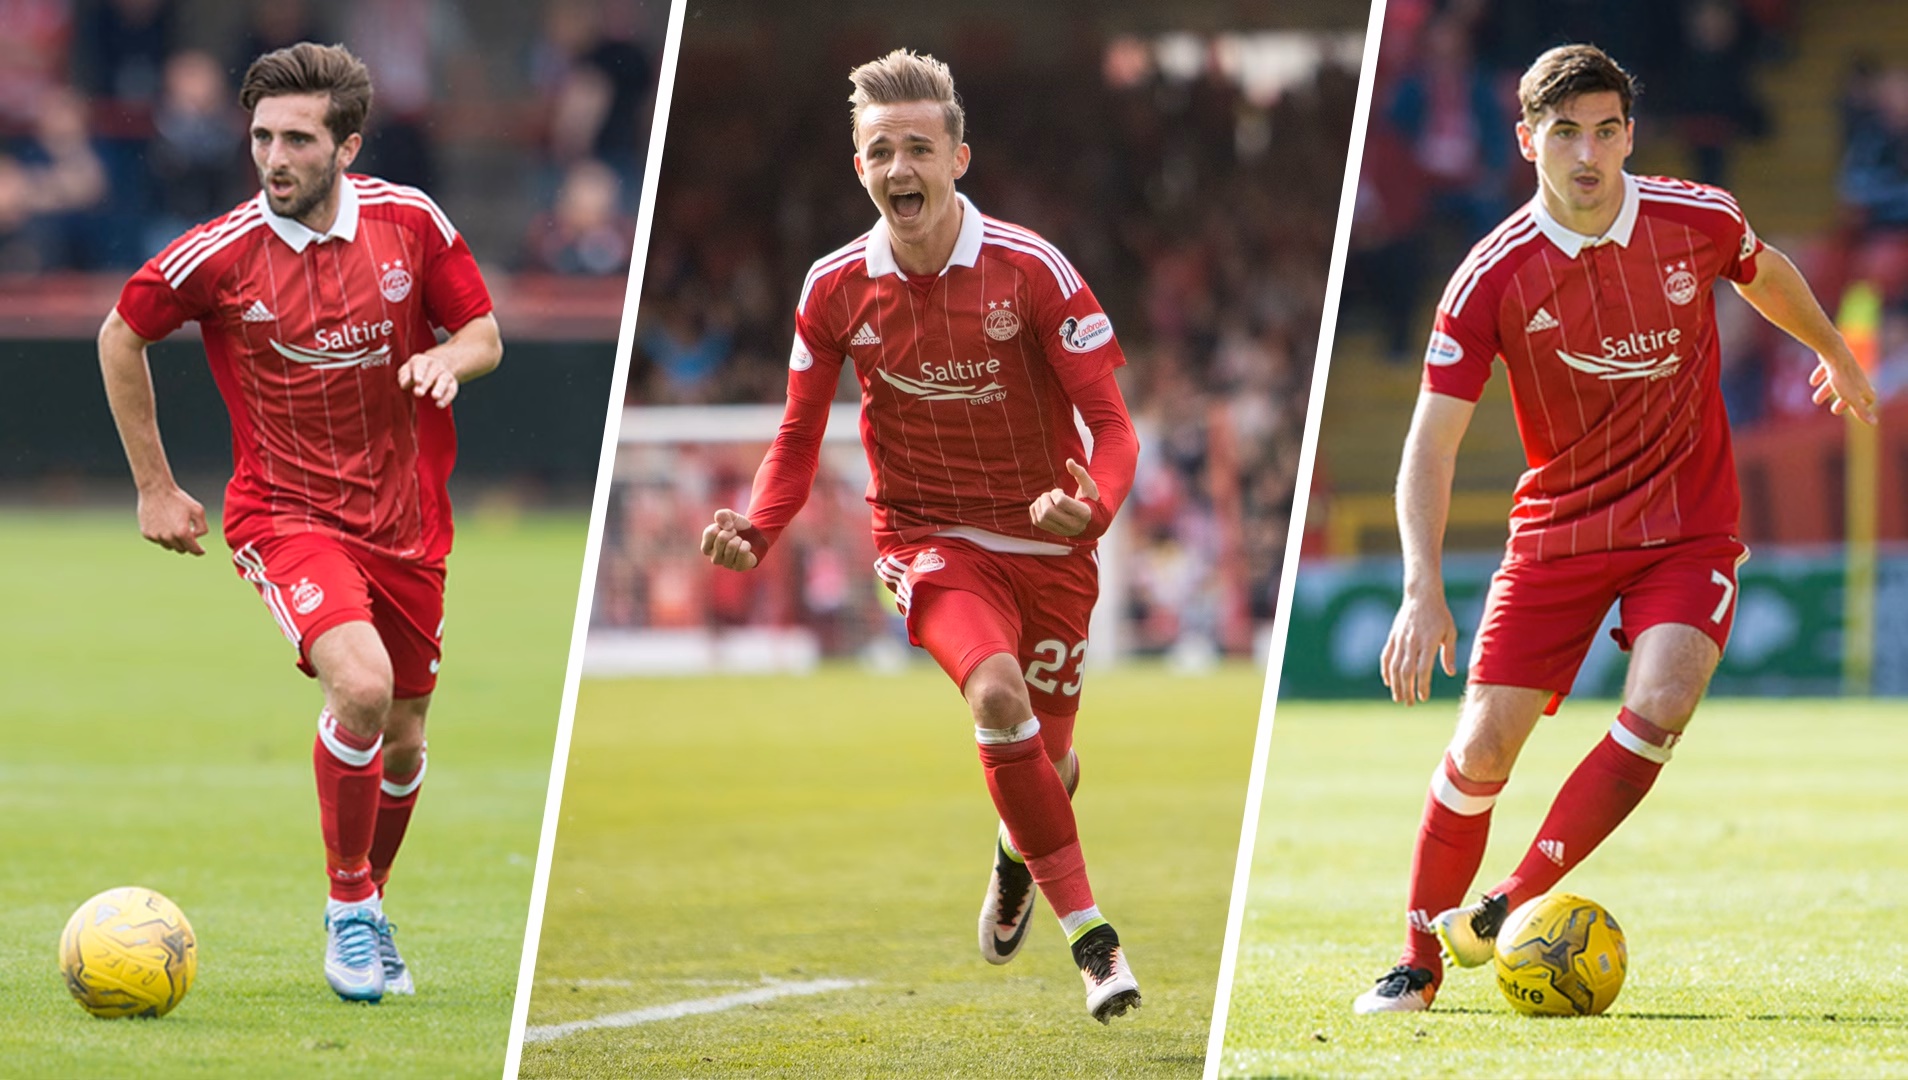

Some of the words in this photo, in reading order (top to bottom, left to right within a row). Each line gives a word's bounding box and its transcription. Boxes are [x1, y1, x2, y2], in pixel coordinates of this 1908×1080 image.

[315, 319, 394, 351] Saltire
[850, 335, 881, 346] adidas
[1077, 317, 1108, 338] Ladbrokes
[1601, 327, 1681, 359] Saltire
[920, 358, 1001, 383] Saltire
[969, 390, 1008, 407] energy
[1710, 568, 1735, 625] 7
[1024, 639, 1088, 697] 23
